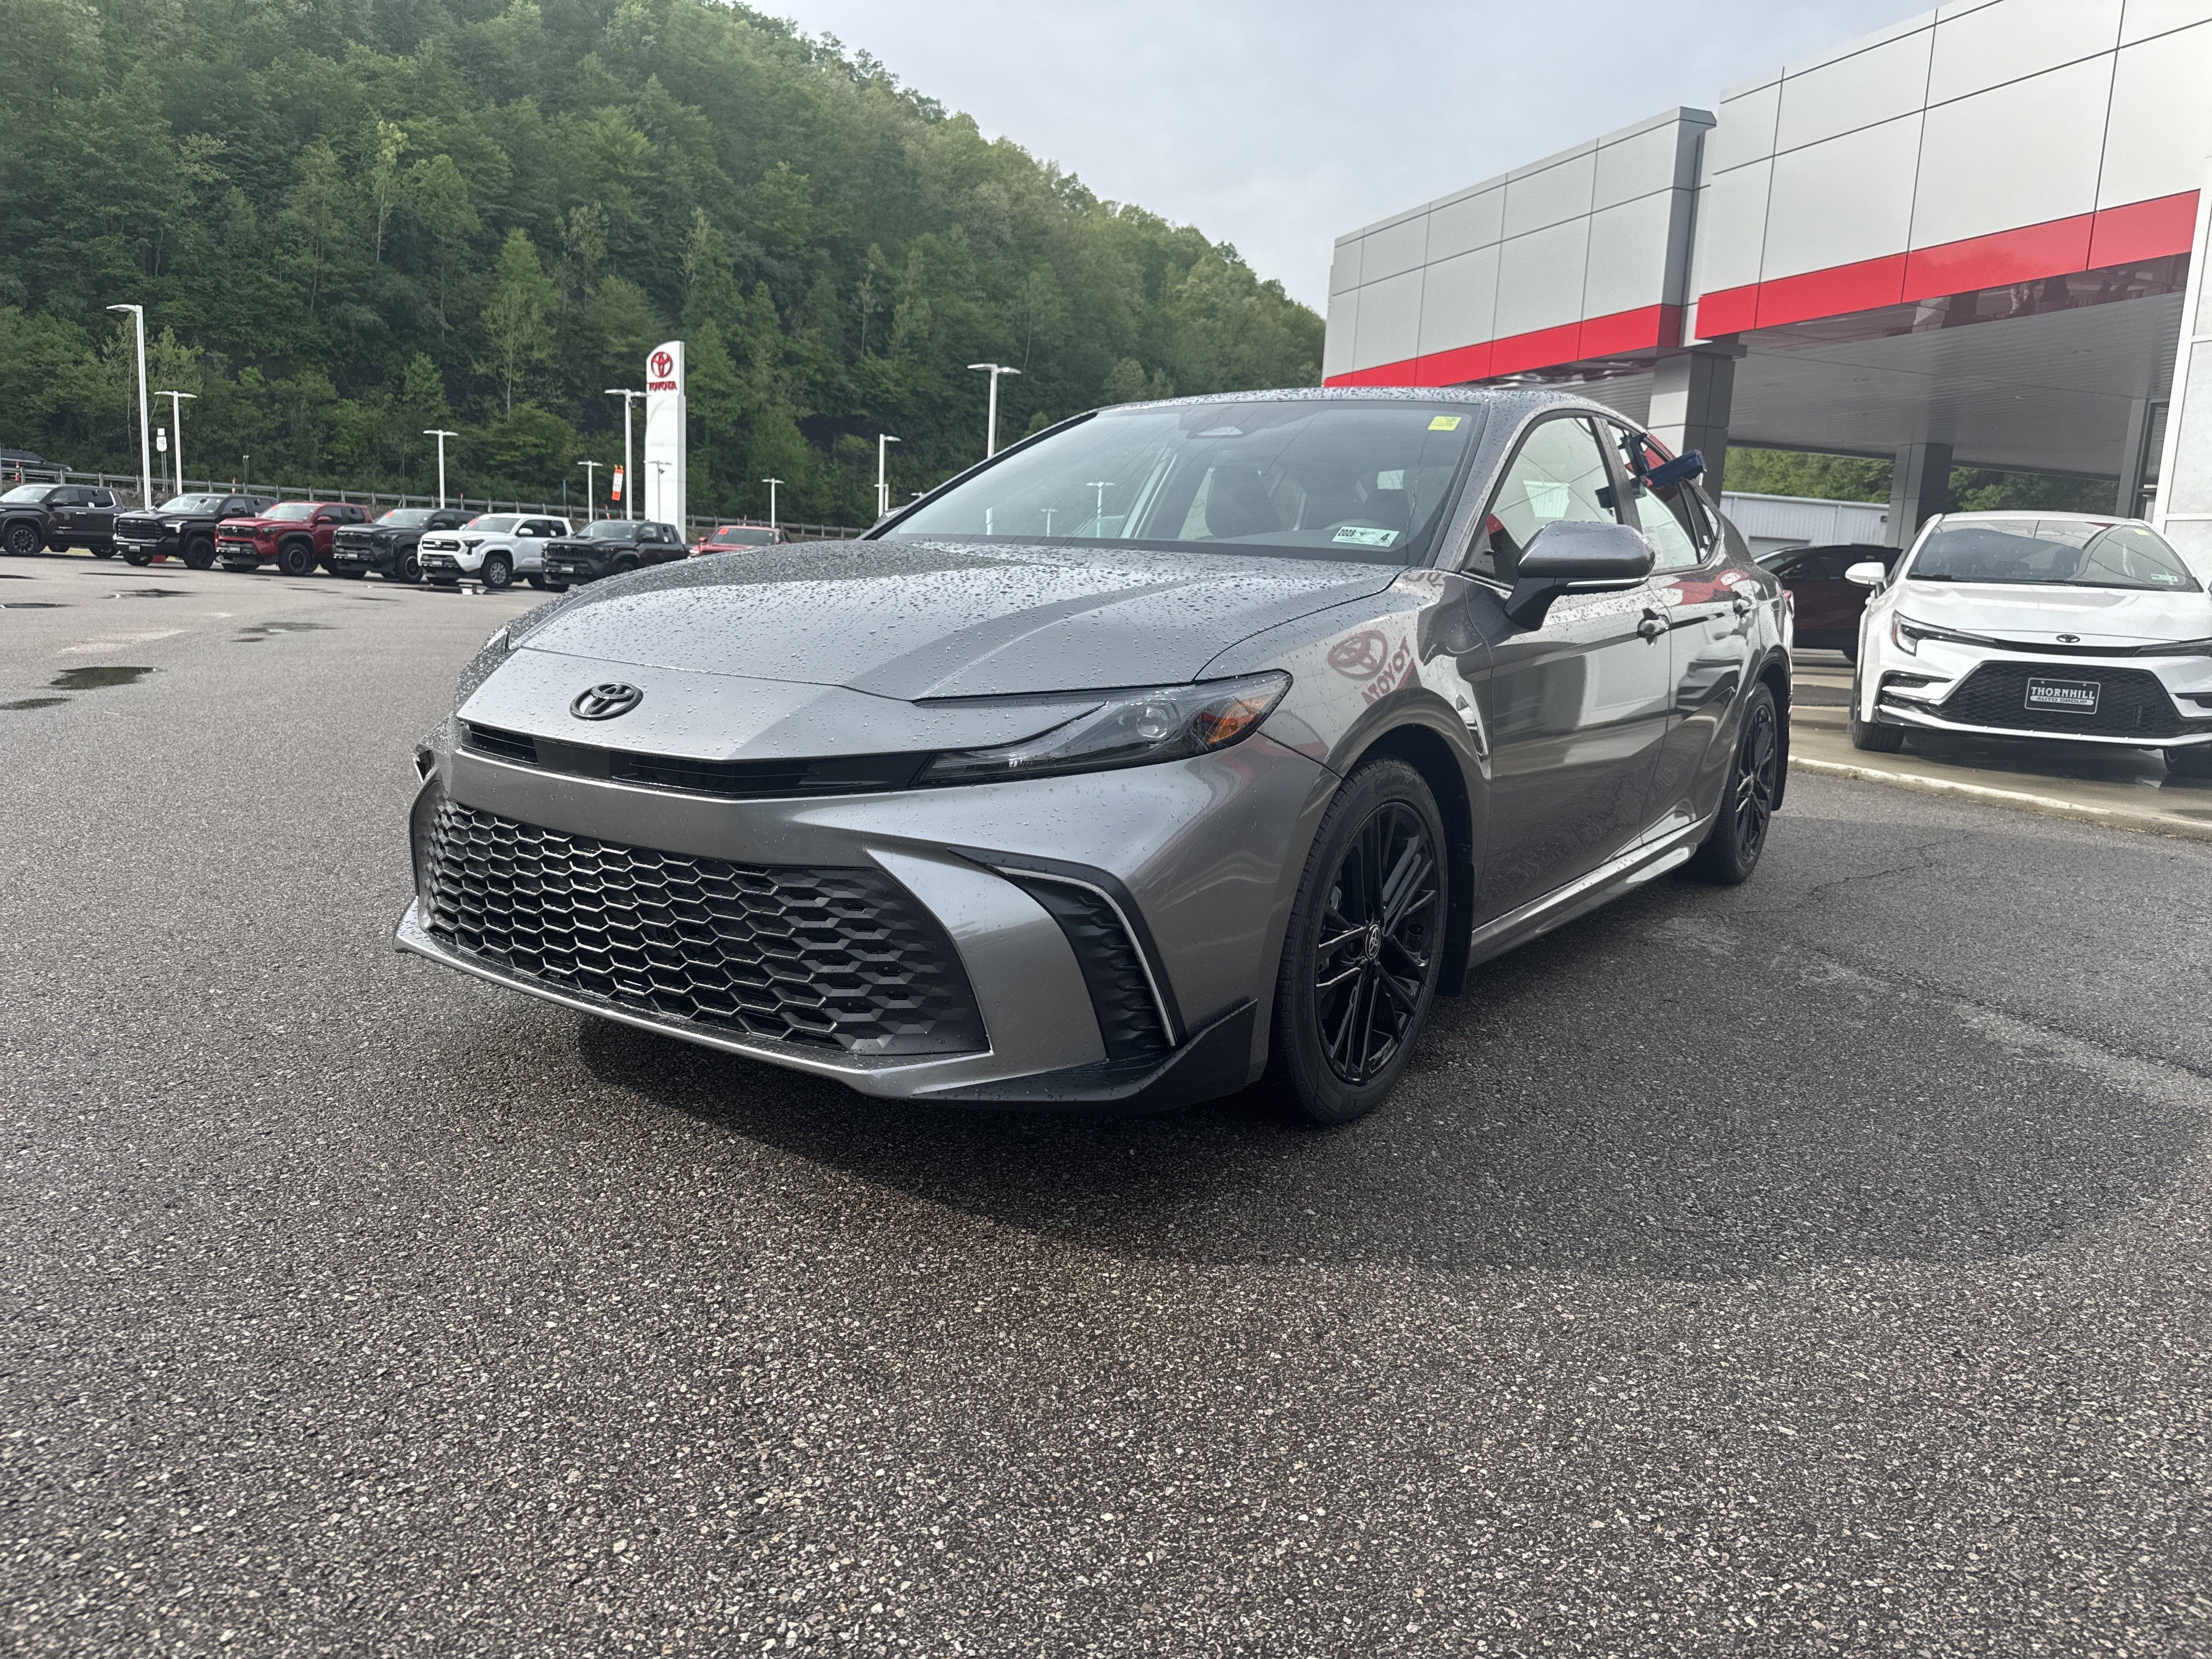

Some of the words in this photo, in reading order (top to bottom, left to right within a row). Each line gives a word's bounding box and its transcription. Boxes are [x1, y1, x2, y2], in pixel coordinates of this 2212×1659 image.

[648, 381, 678, 392] TOYOTA
[1337, 529, 1357, 537] 2028
[1380, 533, 1391, 541] 4
[2030, 686, 2095, 699] THORNHILL
